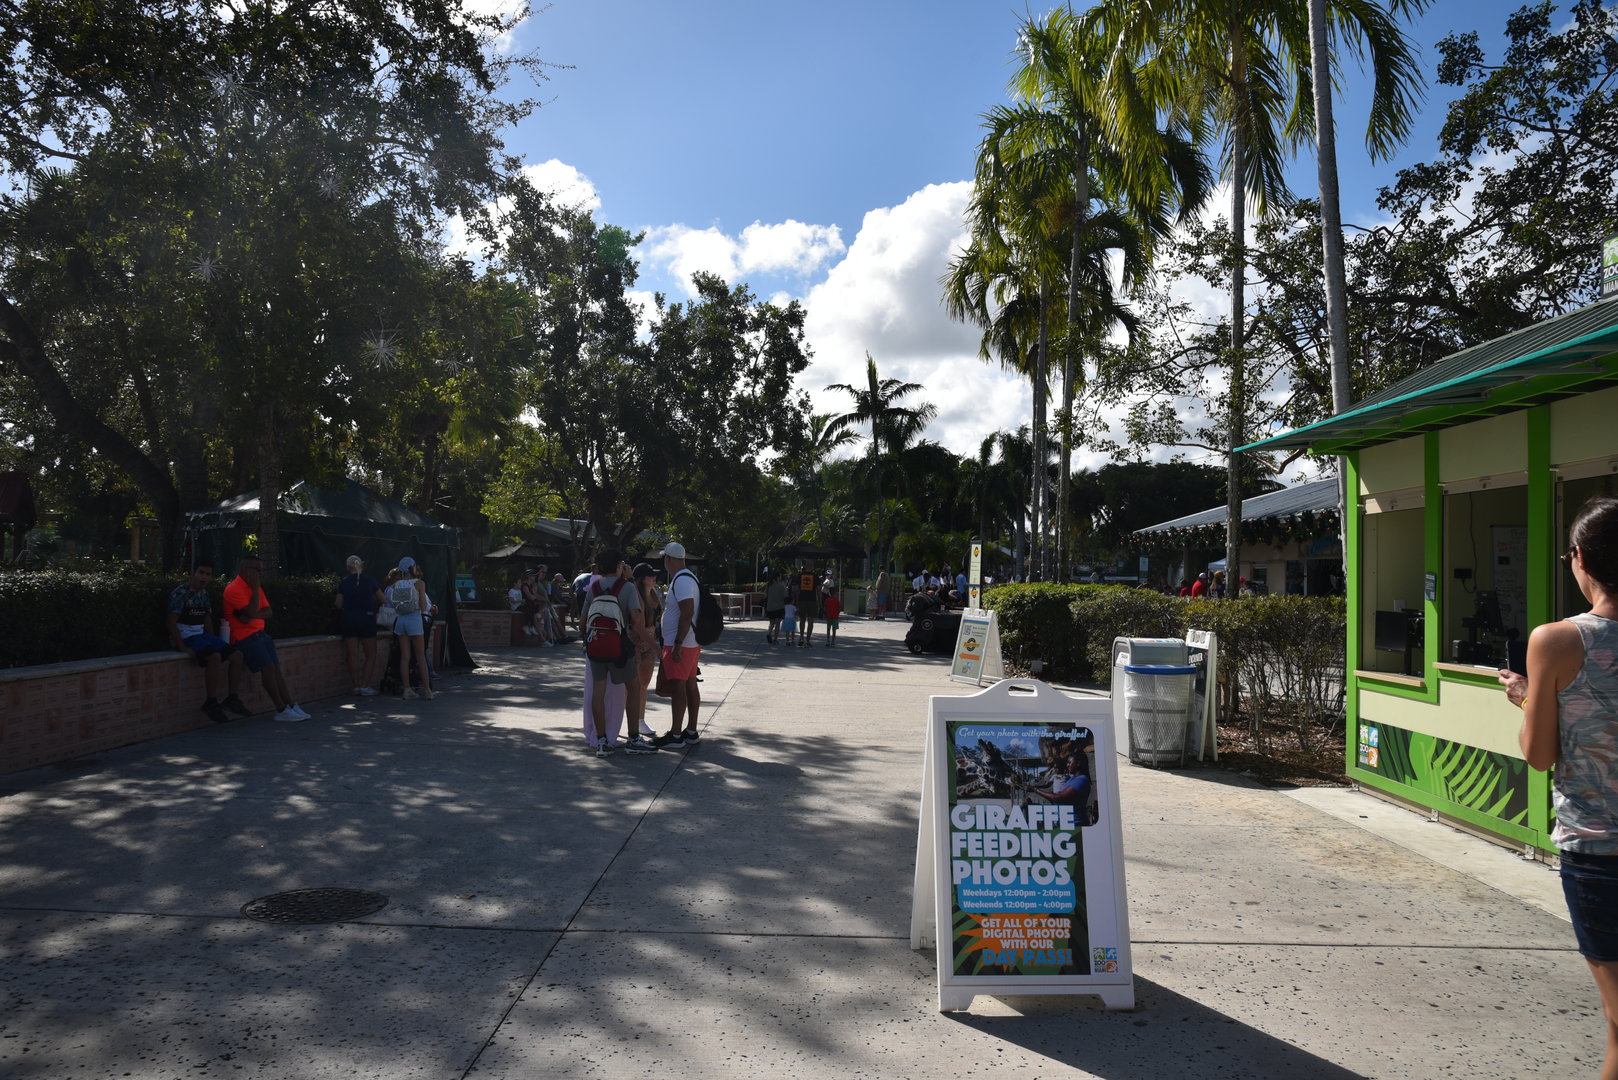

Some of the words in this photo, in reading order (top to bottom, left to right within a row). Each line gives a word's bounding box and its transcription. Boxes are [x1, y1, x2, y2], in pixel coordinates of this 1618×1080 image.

[959, 727, 974, 737] Get
[976, 730, 995, 739] your
[997, 728, 1019, 739] photo
[1021, 728, 1038, 737] with
[1040, 728, 1054, 737] the
[1054, 729, 1088, 740] giraffes!
[951, 804, 1075, 830] GIRAFFE
[952, 832, 1076, 858] FEEDING
[953, 860, 1070, 885] PHOTOS
[963, 889, 1002, 898] Weekdays
[1004, 889, 1036, 898] 12:00pm
[1042, 889, 1071, 898] 2:00pm
[1005, 901, 1037, 910] 12:00pm
[1044, 901, 1073, 910] 4:00pm
[981, 918, 1000, 928] GET
[1003, 918, 1022, 928] ALL
[1024, 918, 1039, 928] OF
[1040, 918, 1071, 928] YOUR
[982, 928, 1024, 938] DIGITAL
[1026, 928, 1071, 938] PHOTOS
[1000, 940, 1028, 948] WITH
[1030, 940, 1054, 948] OUR
[982, 949, 1018, 965] DAY
[1022, 949, 1073, 966] PASS!
